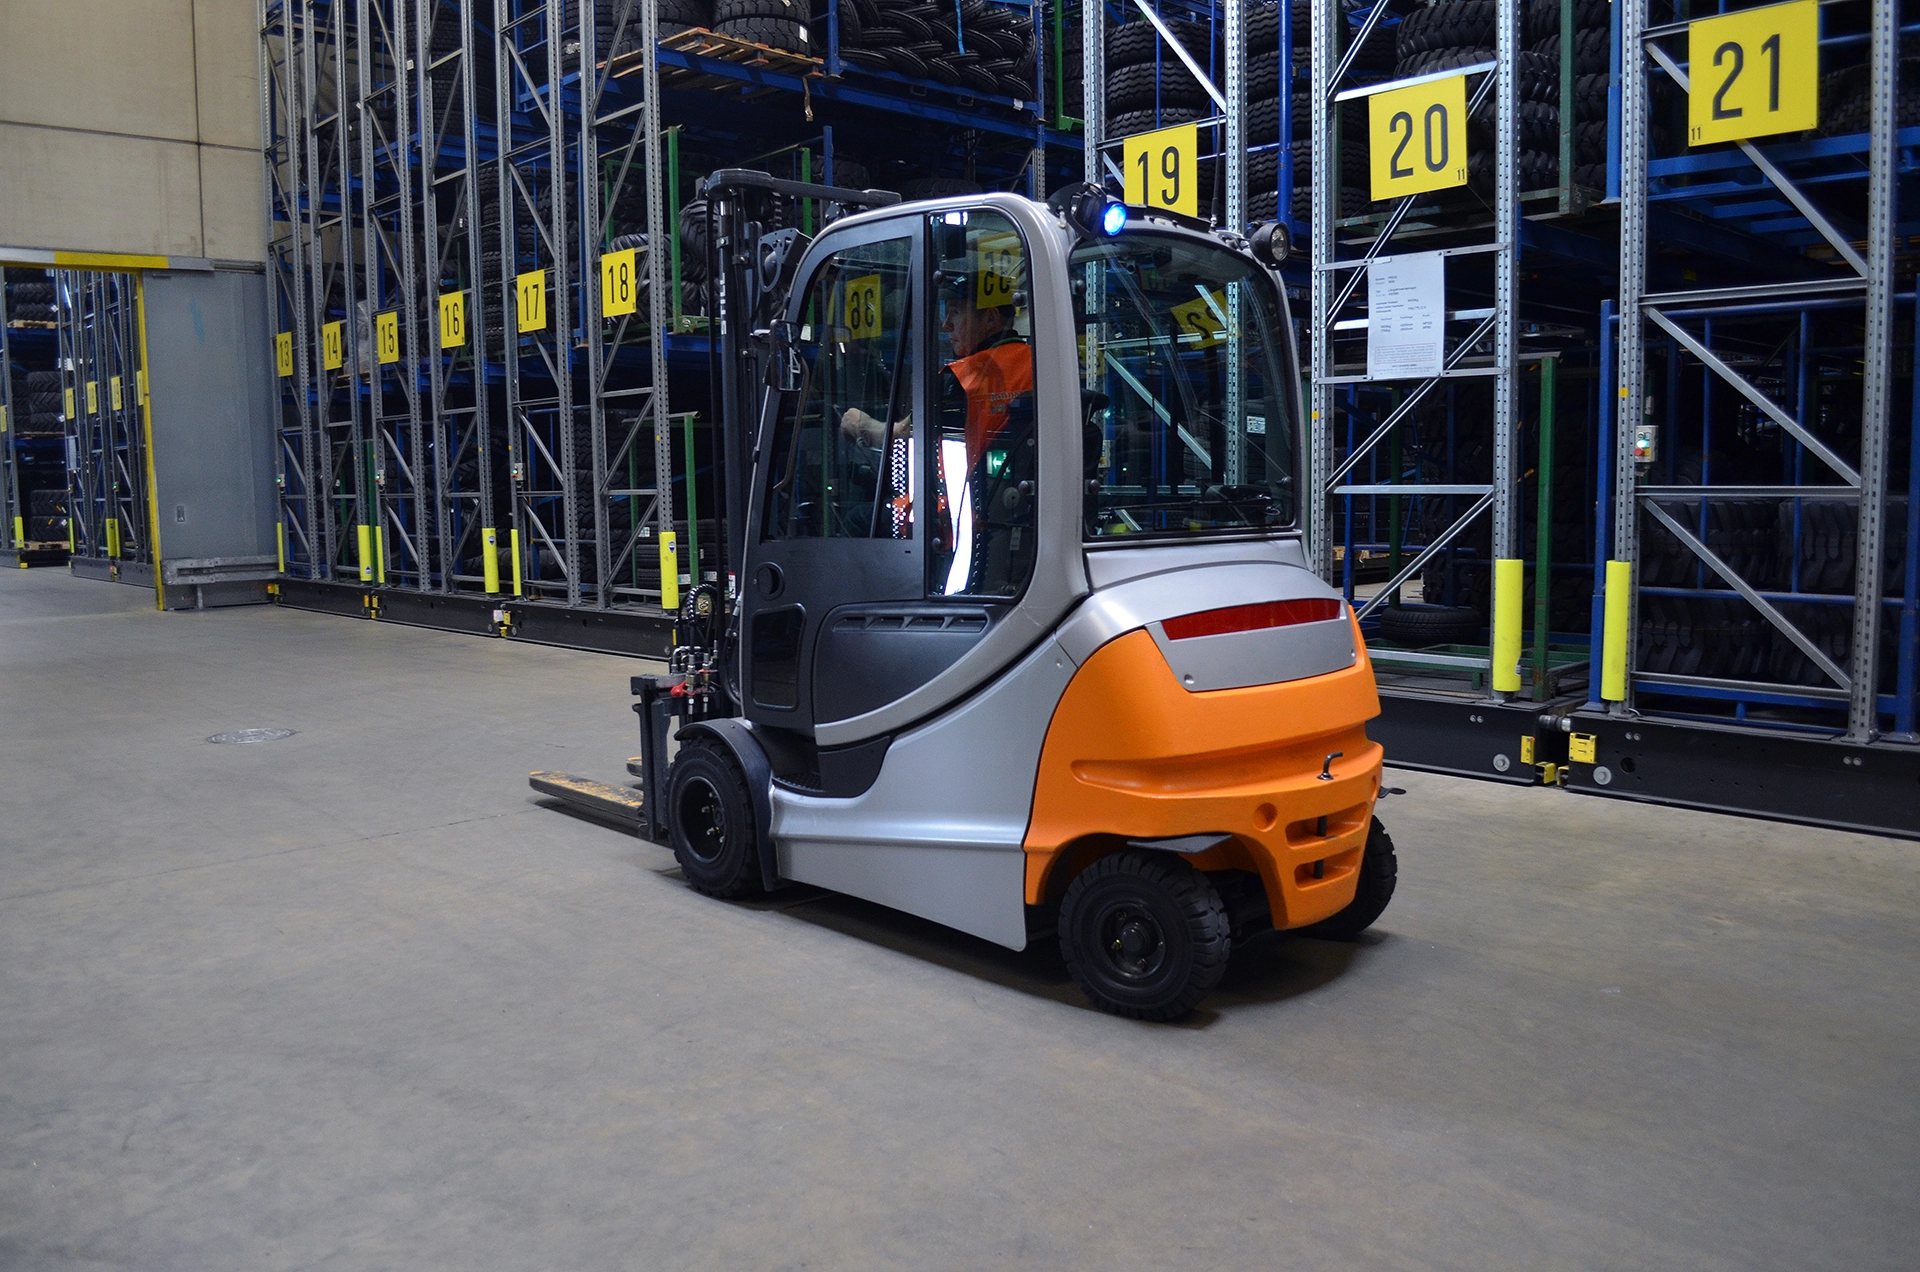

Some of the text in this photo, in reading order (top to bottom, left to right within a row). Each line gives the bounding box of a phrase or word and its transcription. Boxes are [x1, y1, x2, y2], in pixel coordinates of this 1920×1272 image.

[1711, 33, 1781, 121] 21
[1389, 103, 1449, 179] 20
[1691, 127, 1701, 140] 11
[1137, 146, 1180, 206] 19
[1457, 168, 1466, 181] 11
[608, 262, 629, 304] 18
[444, 302, 460, 337] 16
[523, 283, 540, 321] 17
[279, 340, 289, 367] 13
[326, 331, 338, 361] 14
[381, 322, 395, 355] 15
